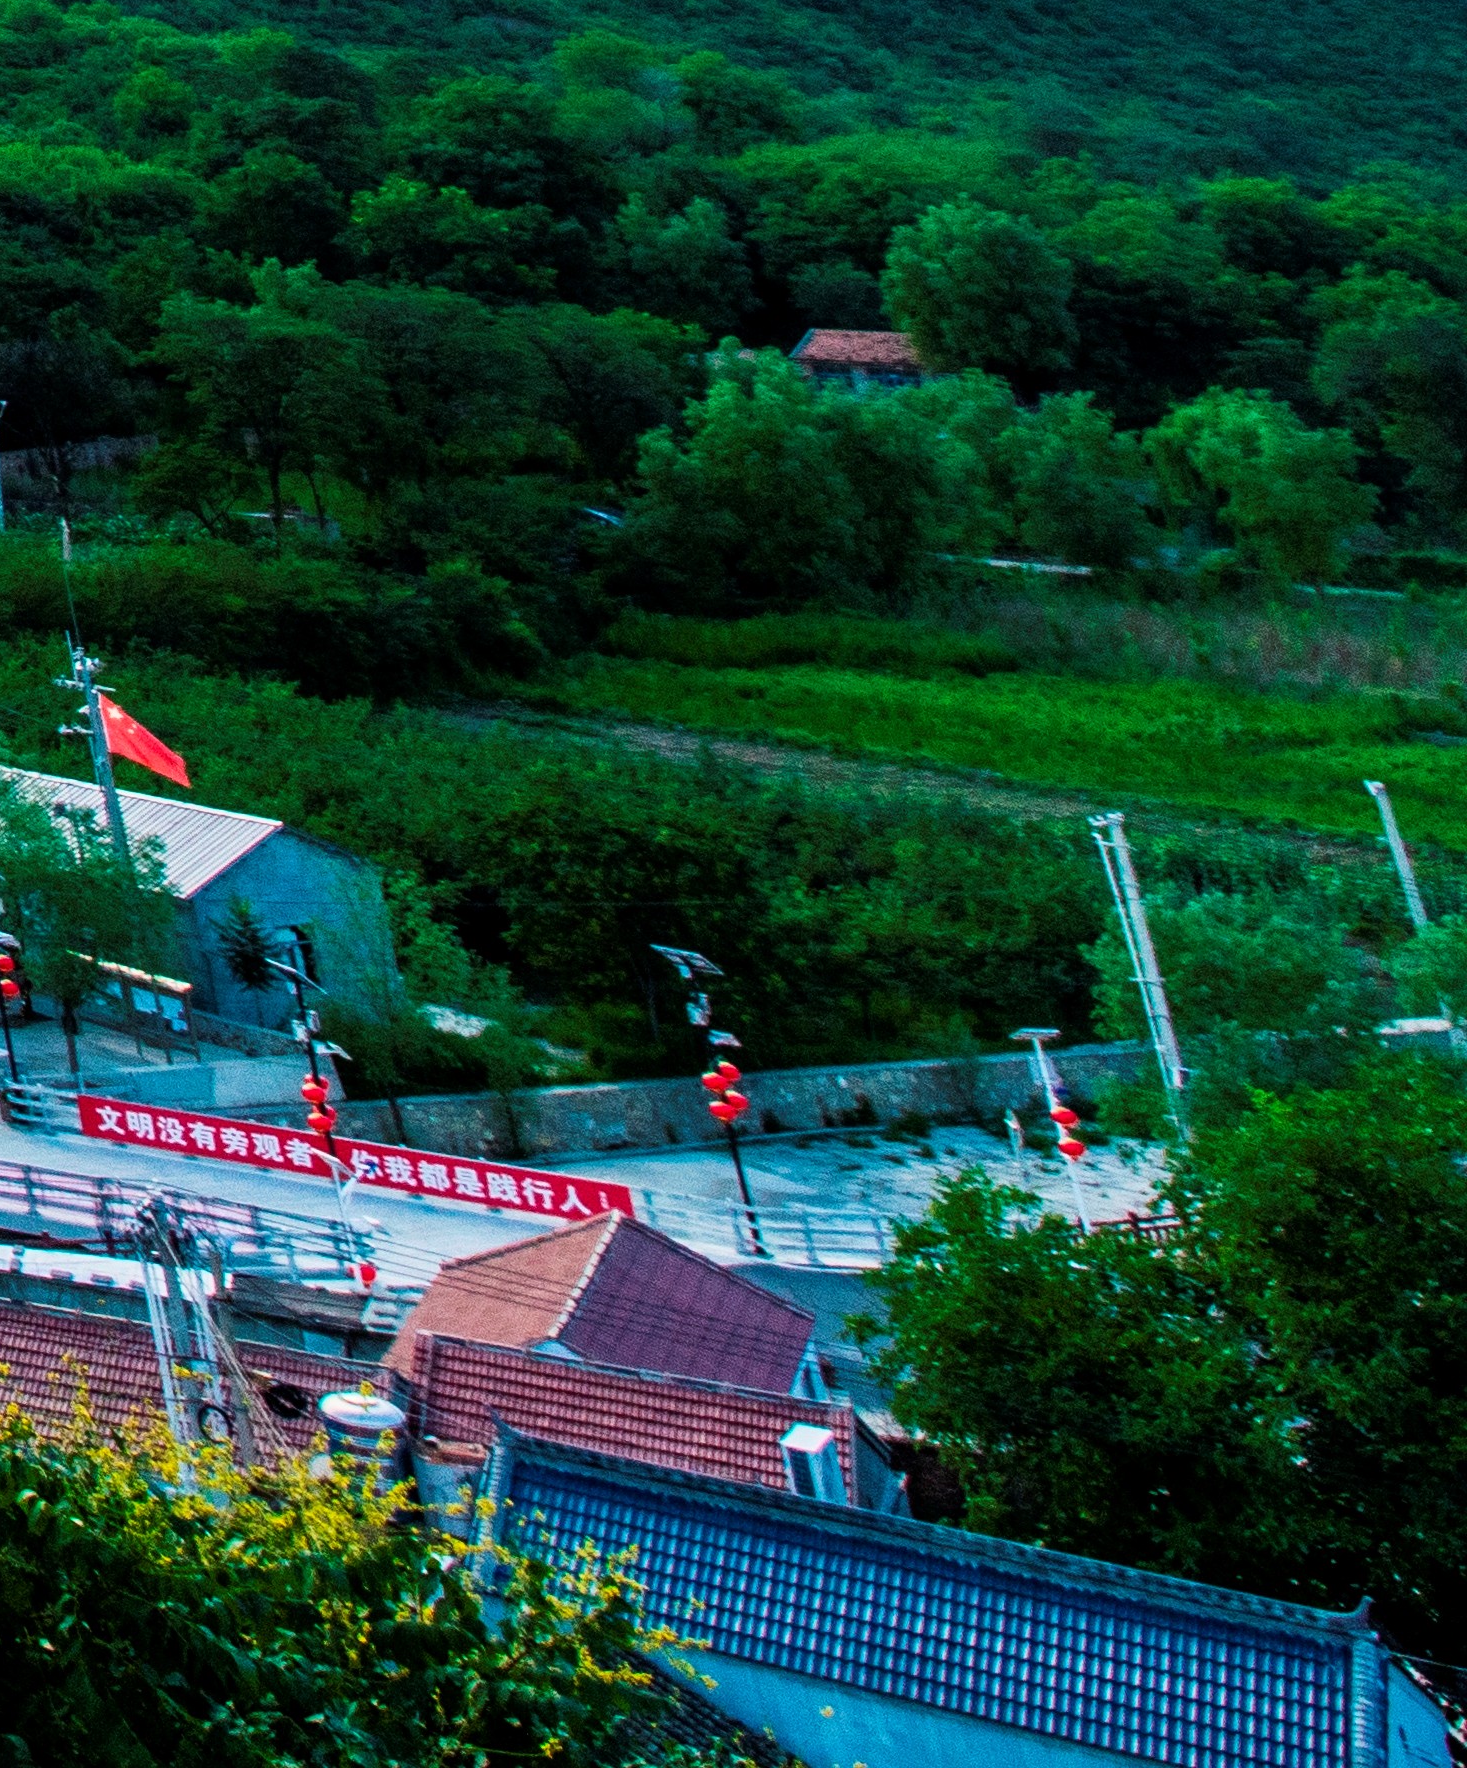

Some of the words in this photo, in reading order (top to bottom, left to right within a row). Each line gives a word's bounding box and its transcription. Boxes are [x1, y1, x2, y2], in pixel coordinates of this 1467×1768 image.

[95, 1105, 314, 1168] 文明没有旁观者
